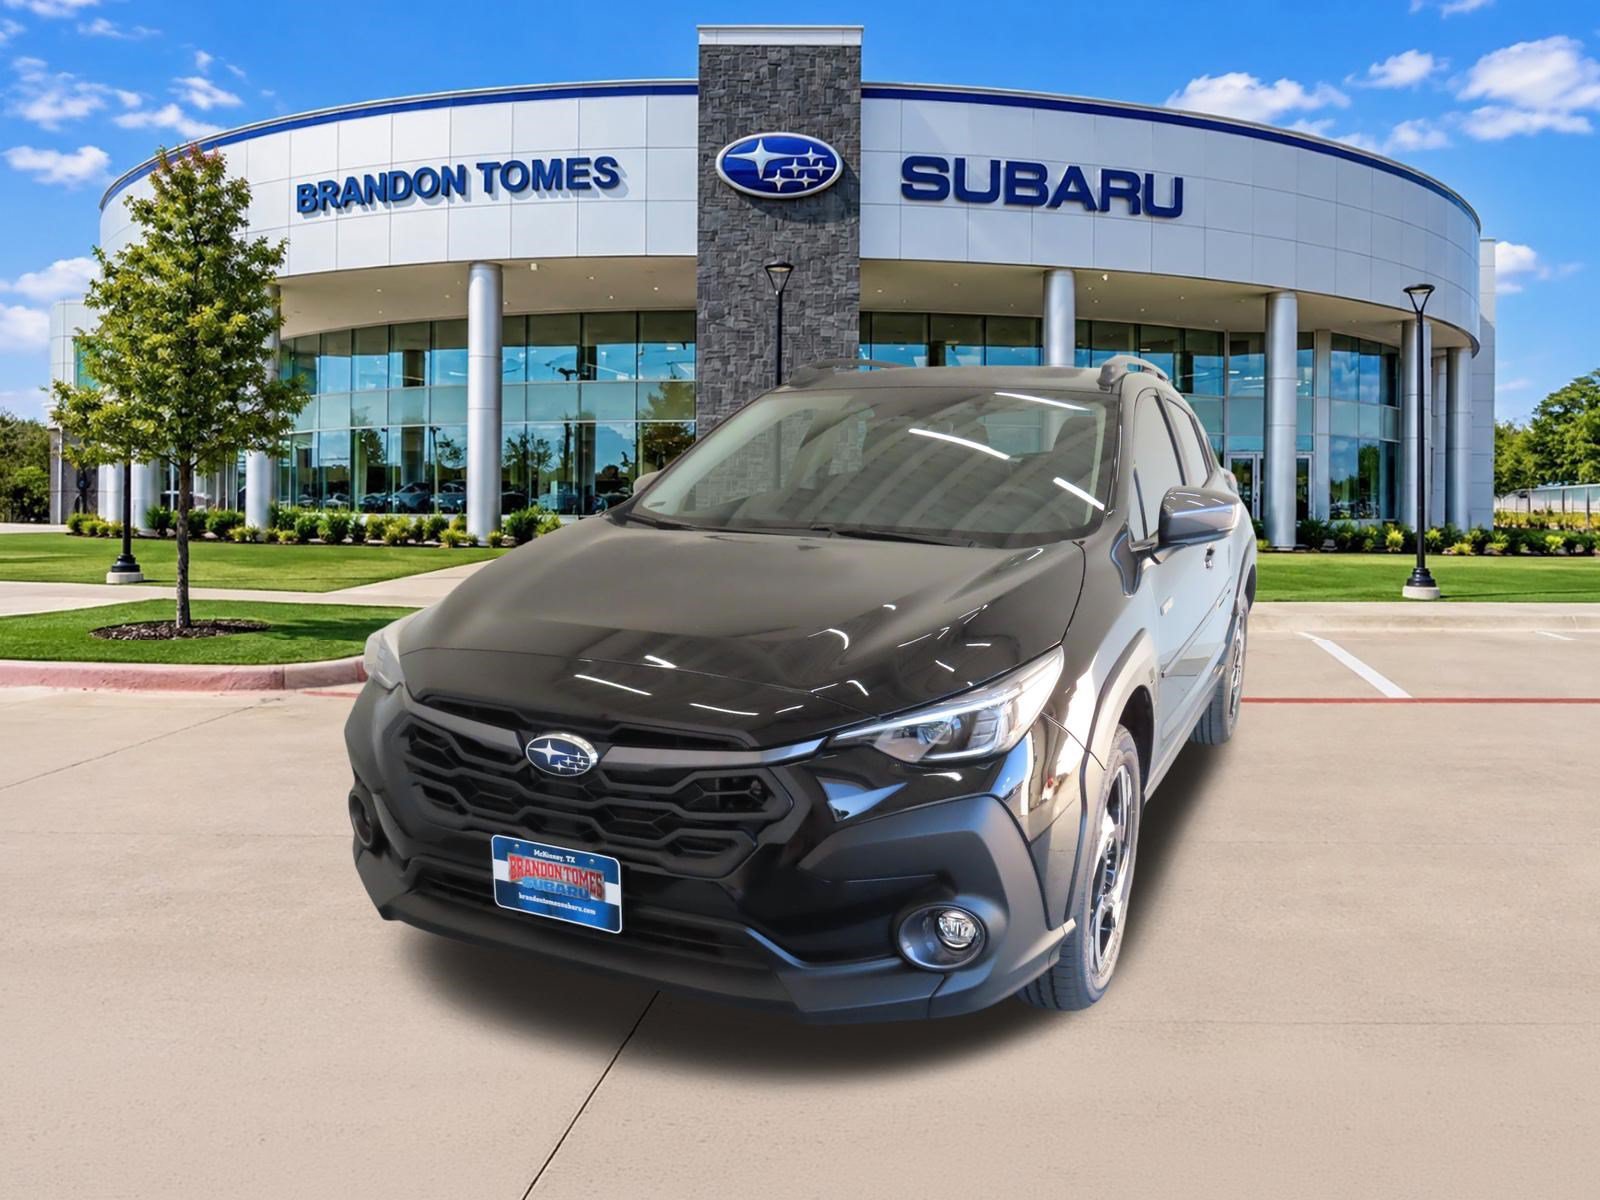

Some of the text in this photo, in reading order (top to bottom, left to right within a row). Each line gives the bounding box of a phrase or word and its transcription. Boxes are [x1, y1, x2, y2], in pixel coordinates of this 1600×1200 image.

[297, 155, 620, 213] BRANDON TOMES
[901, 155, 1183, 218] SUBARU
[566, 855, 576, 864] TX
[508, 854, 605, 899] BRANDON TOMES
[522, 877, 591, 899] SUBARU
[519, 893, 596, 915] brandontomessubaru.com
